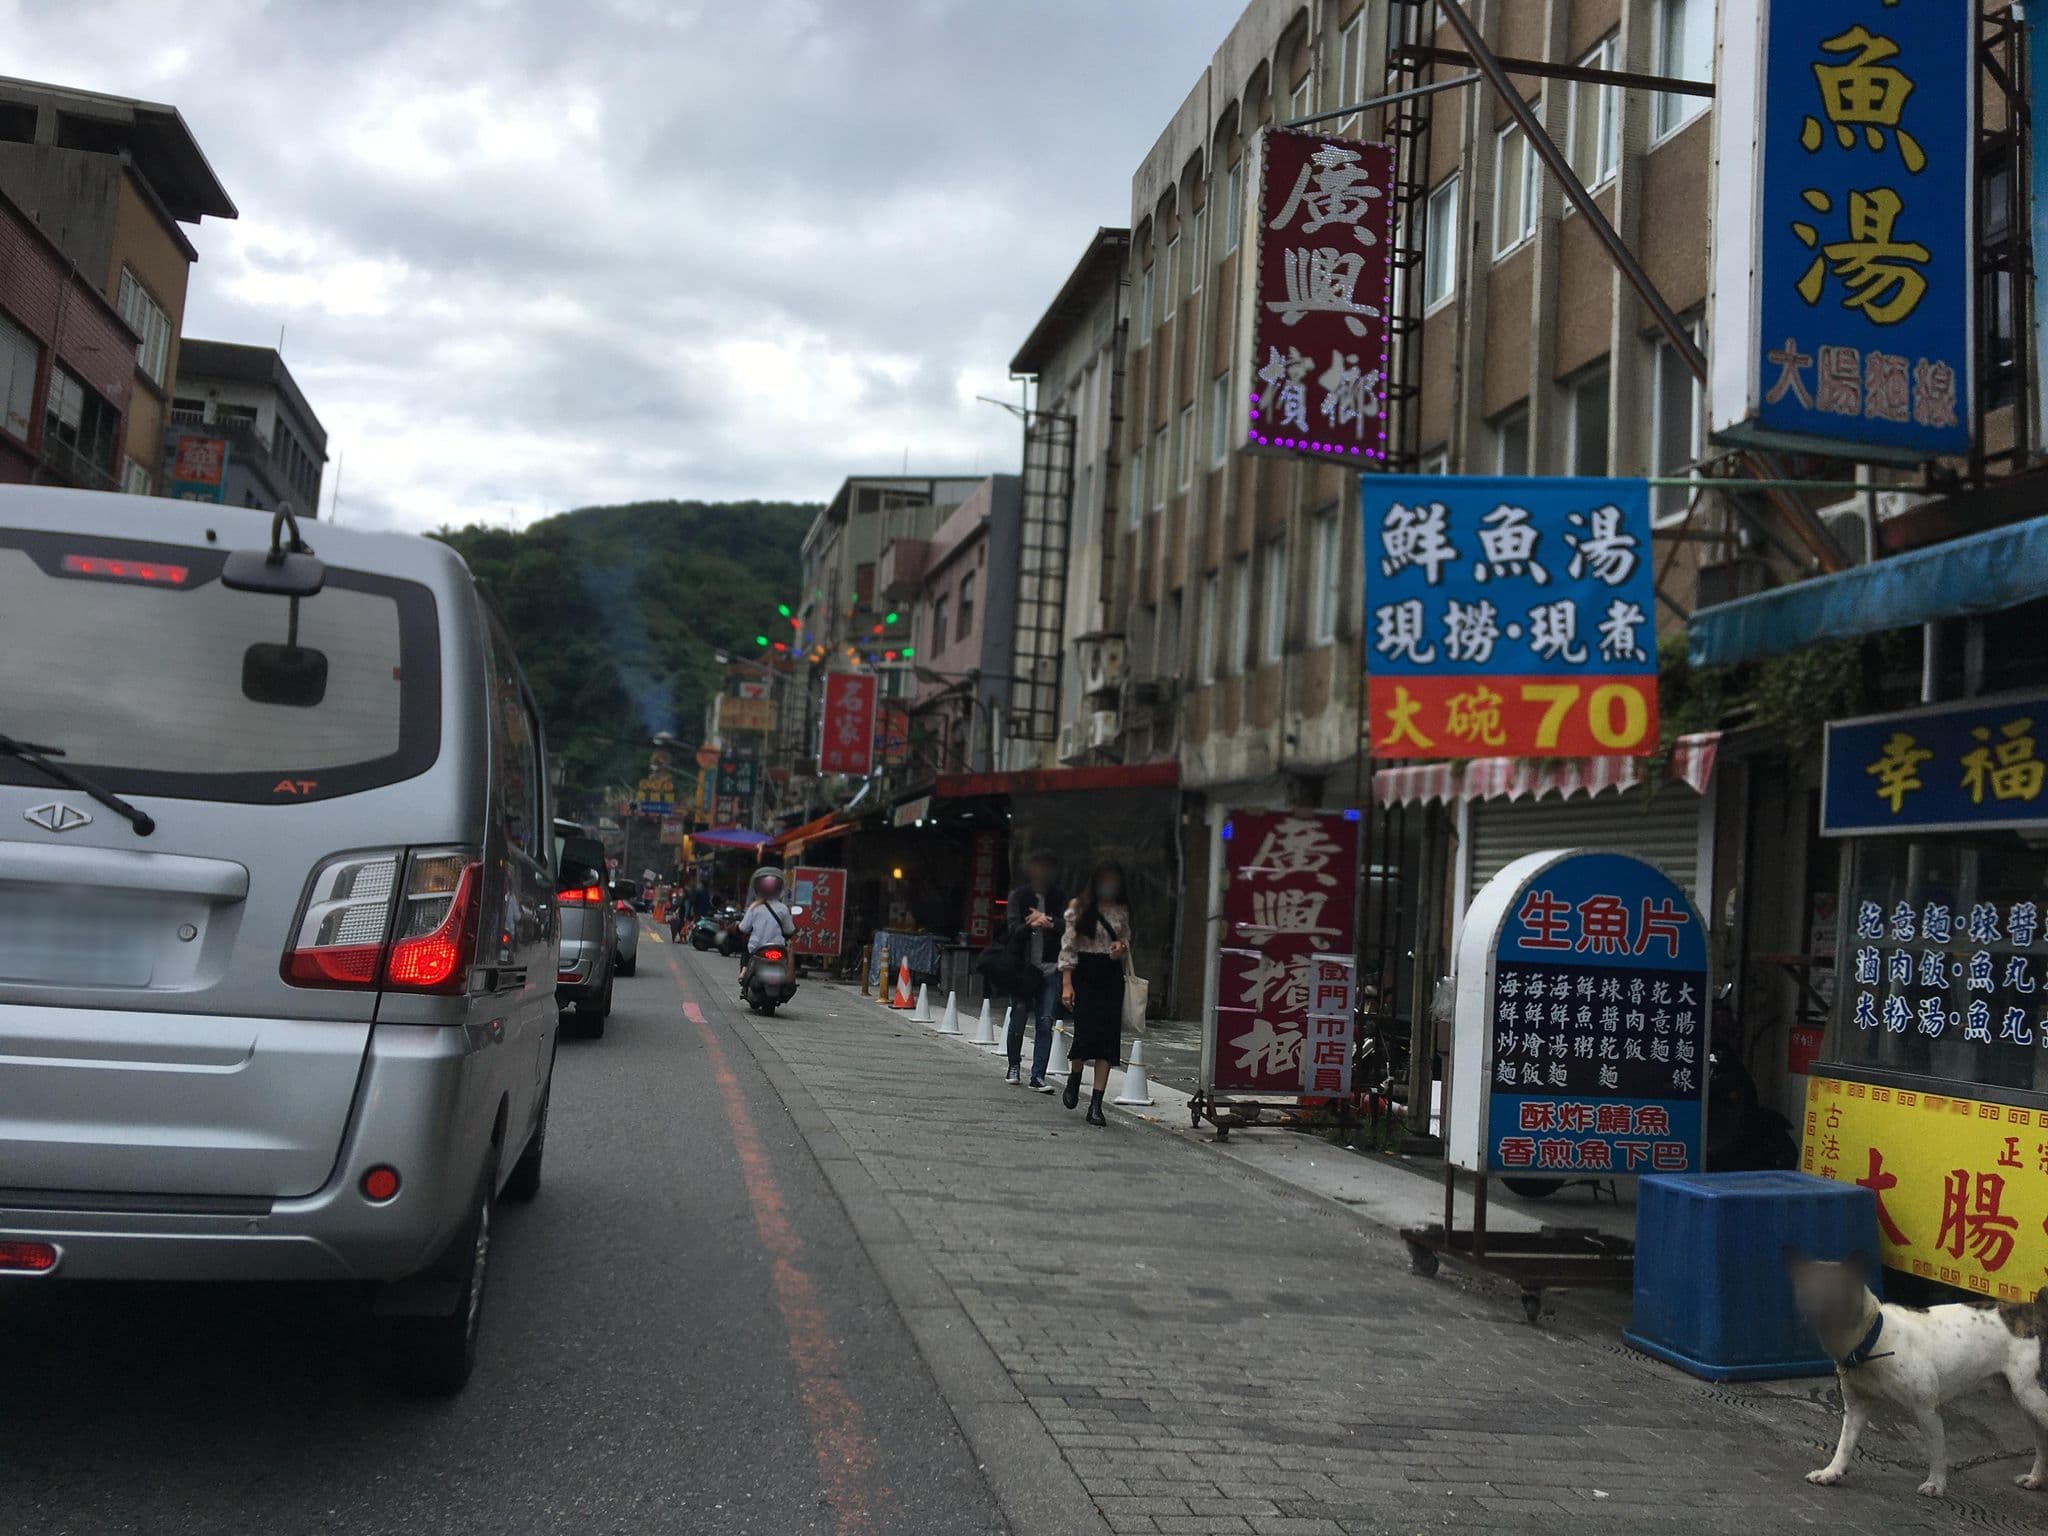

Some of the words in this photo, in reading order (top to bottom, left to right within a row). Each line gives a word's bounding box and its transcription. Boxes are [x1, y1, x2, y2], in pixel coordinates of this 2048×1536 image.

[1792, 0, 1929, 325] 魚湯
[1381, 502, 1637, 585] 鮮魚湯
[272, 779, 318, 795] AT
[1865, 716, 2046, 815] 幸福
[1518, 891, 1690, 958] 生魚片
[1854, 946, 2048, 995] 滷肉飯·魚丸
[1496, 971, 1521, 1086] 海鮮炒麵
[1547, 974, 1573, 1087] 海鮮湯麵
[1574, 975, 1597, 1059] 鮮魚粥
[1623, 978, 1647, 1061] 魯肉飯
[1672, 981, 1697, 1092] 大腸麵線
[1853, 991, 2048, 1048] 米粉湯·魚丸
[1497, 1137, 1689, 1171] 香煎魚下巴
[1519, 1102, 1671, 1136] 酥炸鯖魚
